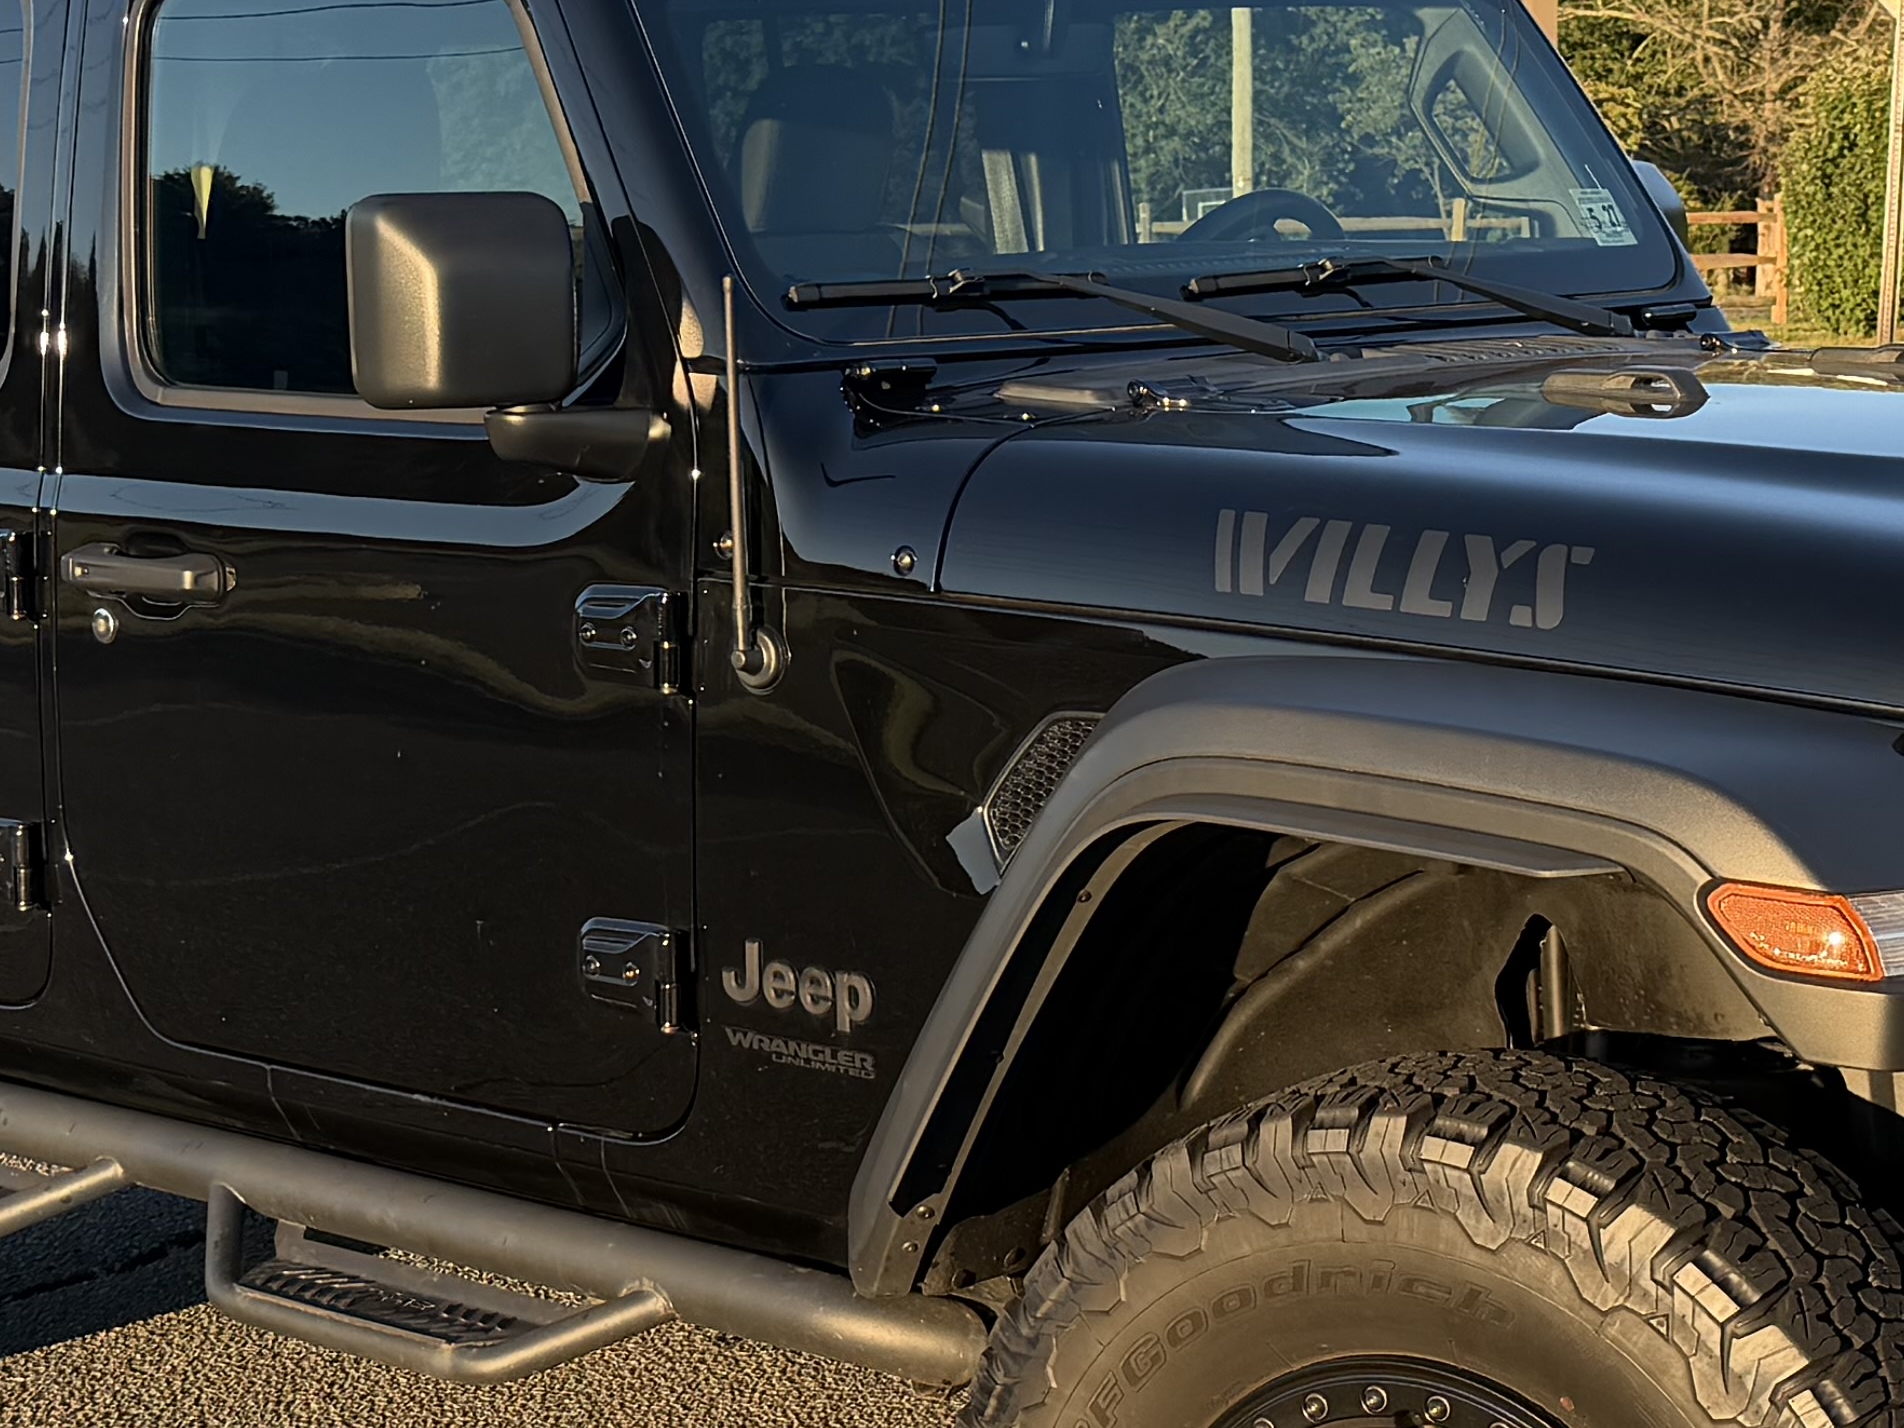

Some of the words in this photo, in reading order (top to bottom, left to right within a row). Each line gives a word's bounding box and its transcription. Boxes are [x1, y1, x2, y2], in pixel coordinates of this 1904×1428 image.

[1214, 508, 1596, 630] WILLYS
[721, 938, 877, 1033] Jeep
[725, 1026, 875, 1071] WRANGLER
[771, 1053, 876, 1079] UNLIMITED
